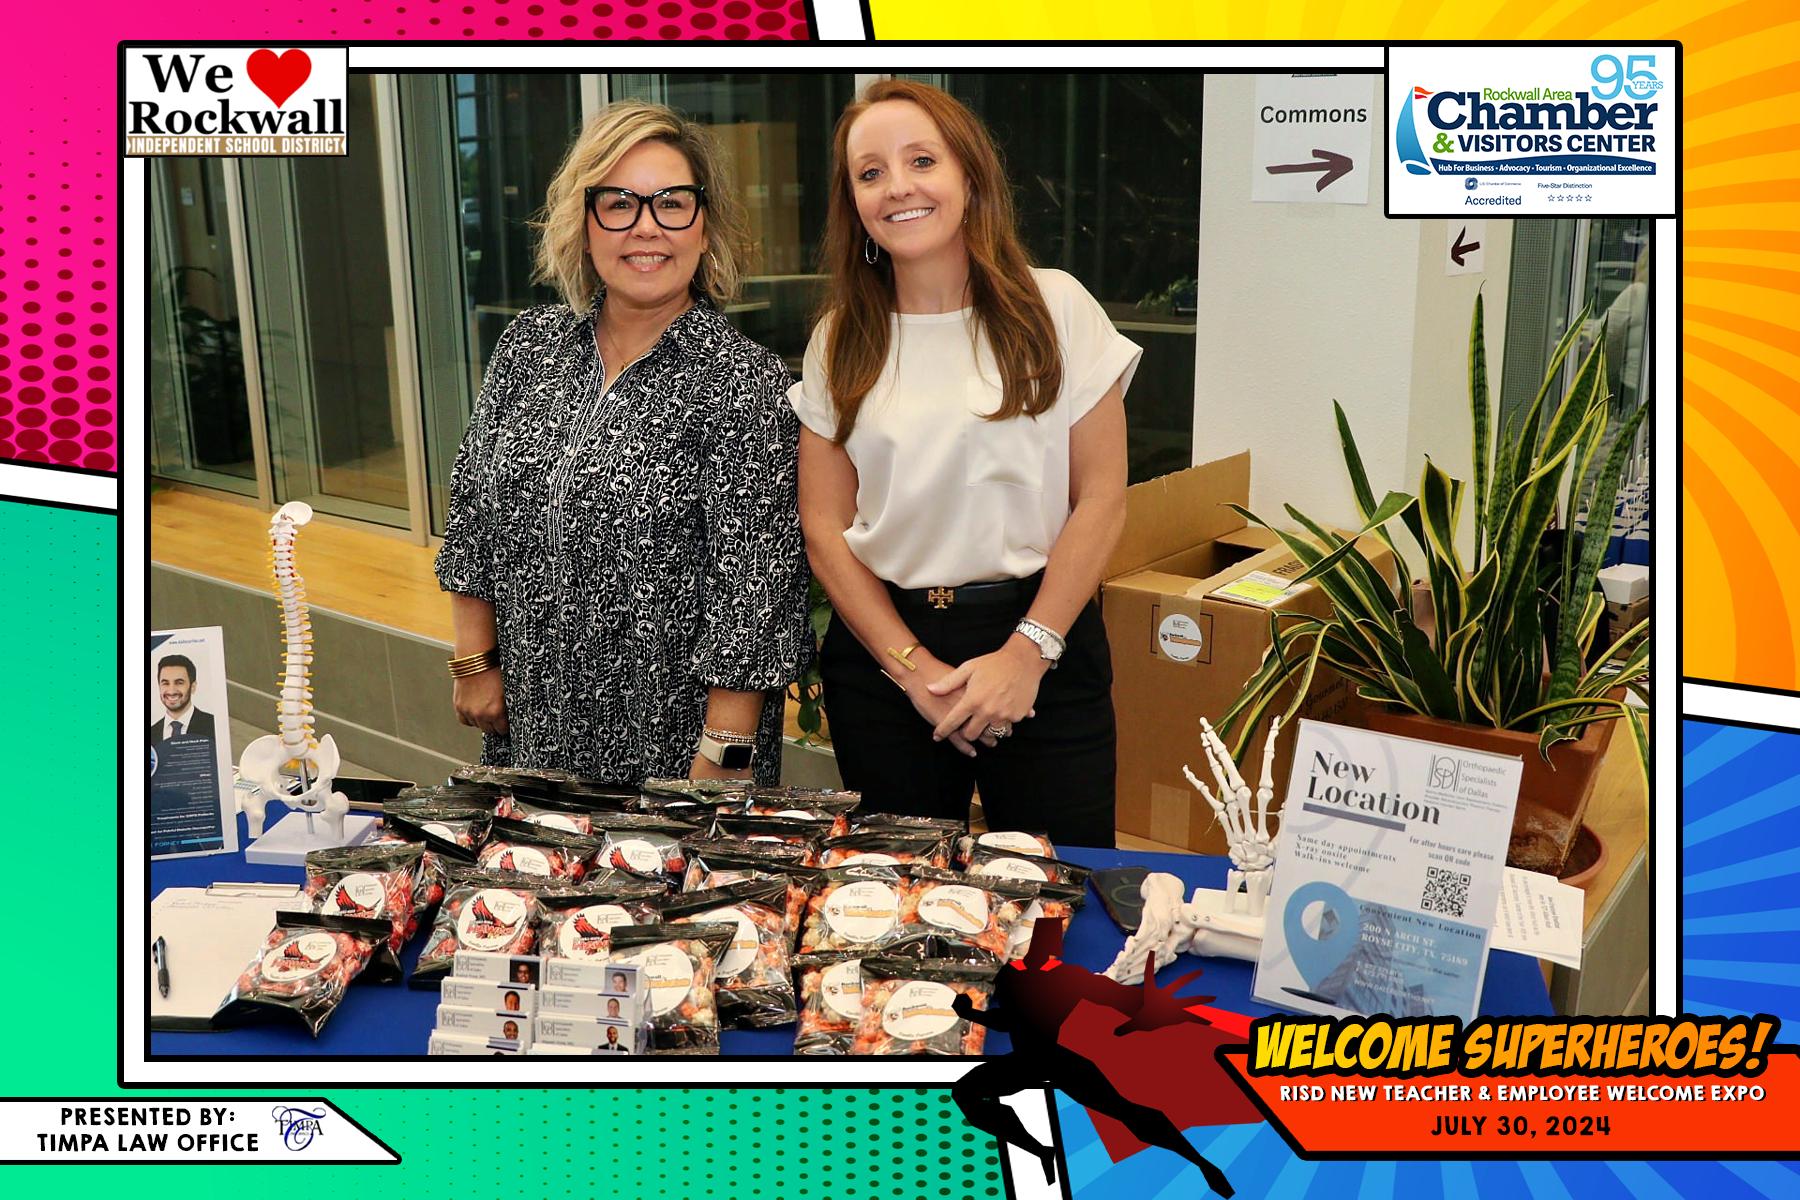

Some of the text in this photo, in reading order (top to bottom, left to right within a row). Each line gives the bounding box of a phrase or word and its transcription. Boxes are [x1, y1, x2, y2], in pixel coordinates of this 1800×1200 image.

[1260, 106, 1367, 123] Commons
[1310, 750, 1376, 784] New
[1462, 760, 1507, 776] Orthopaedic
[1461, 774, 1497, 787] Specialists
[1307, 776, 1440, 825] Location
[1459, 786, 1489, 799] of Dallas
[1296, 842, 1318, 853] X-ray
[1297, 834, 1397, 862] Same day appointments
[1334, 861, 1370, 873] welcome
[1360, 904, 1481, 940] Convenient New Location
[1361, 933, 1393, 948] ROYSE
[1363, 922, 1381, 934] 200
[1394, 929, 1419, 944] ARCH
